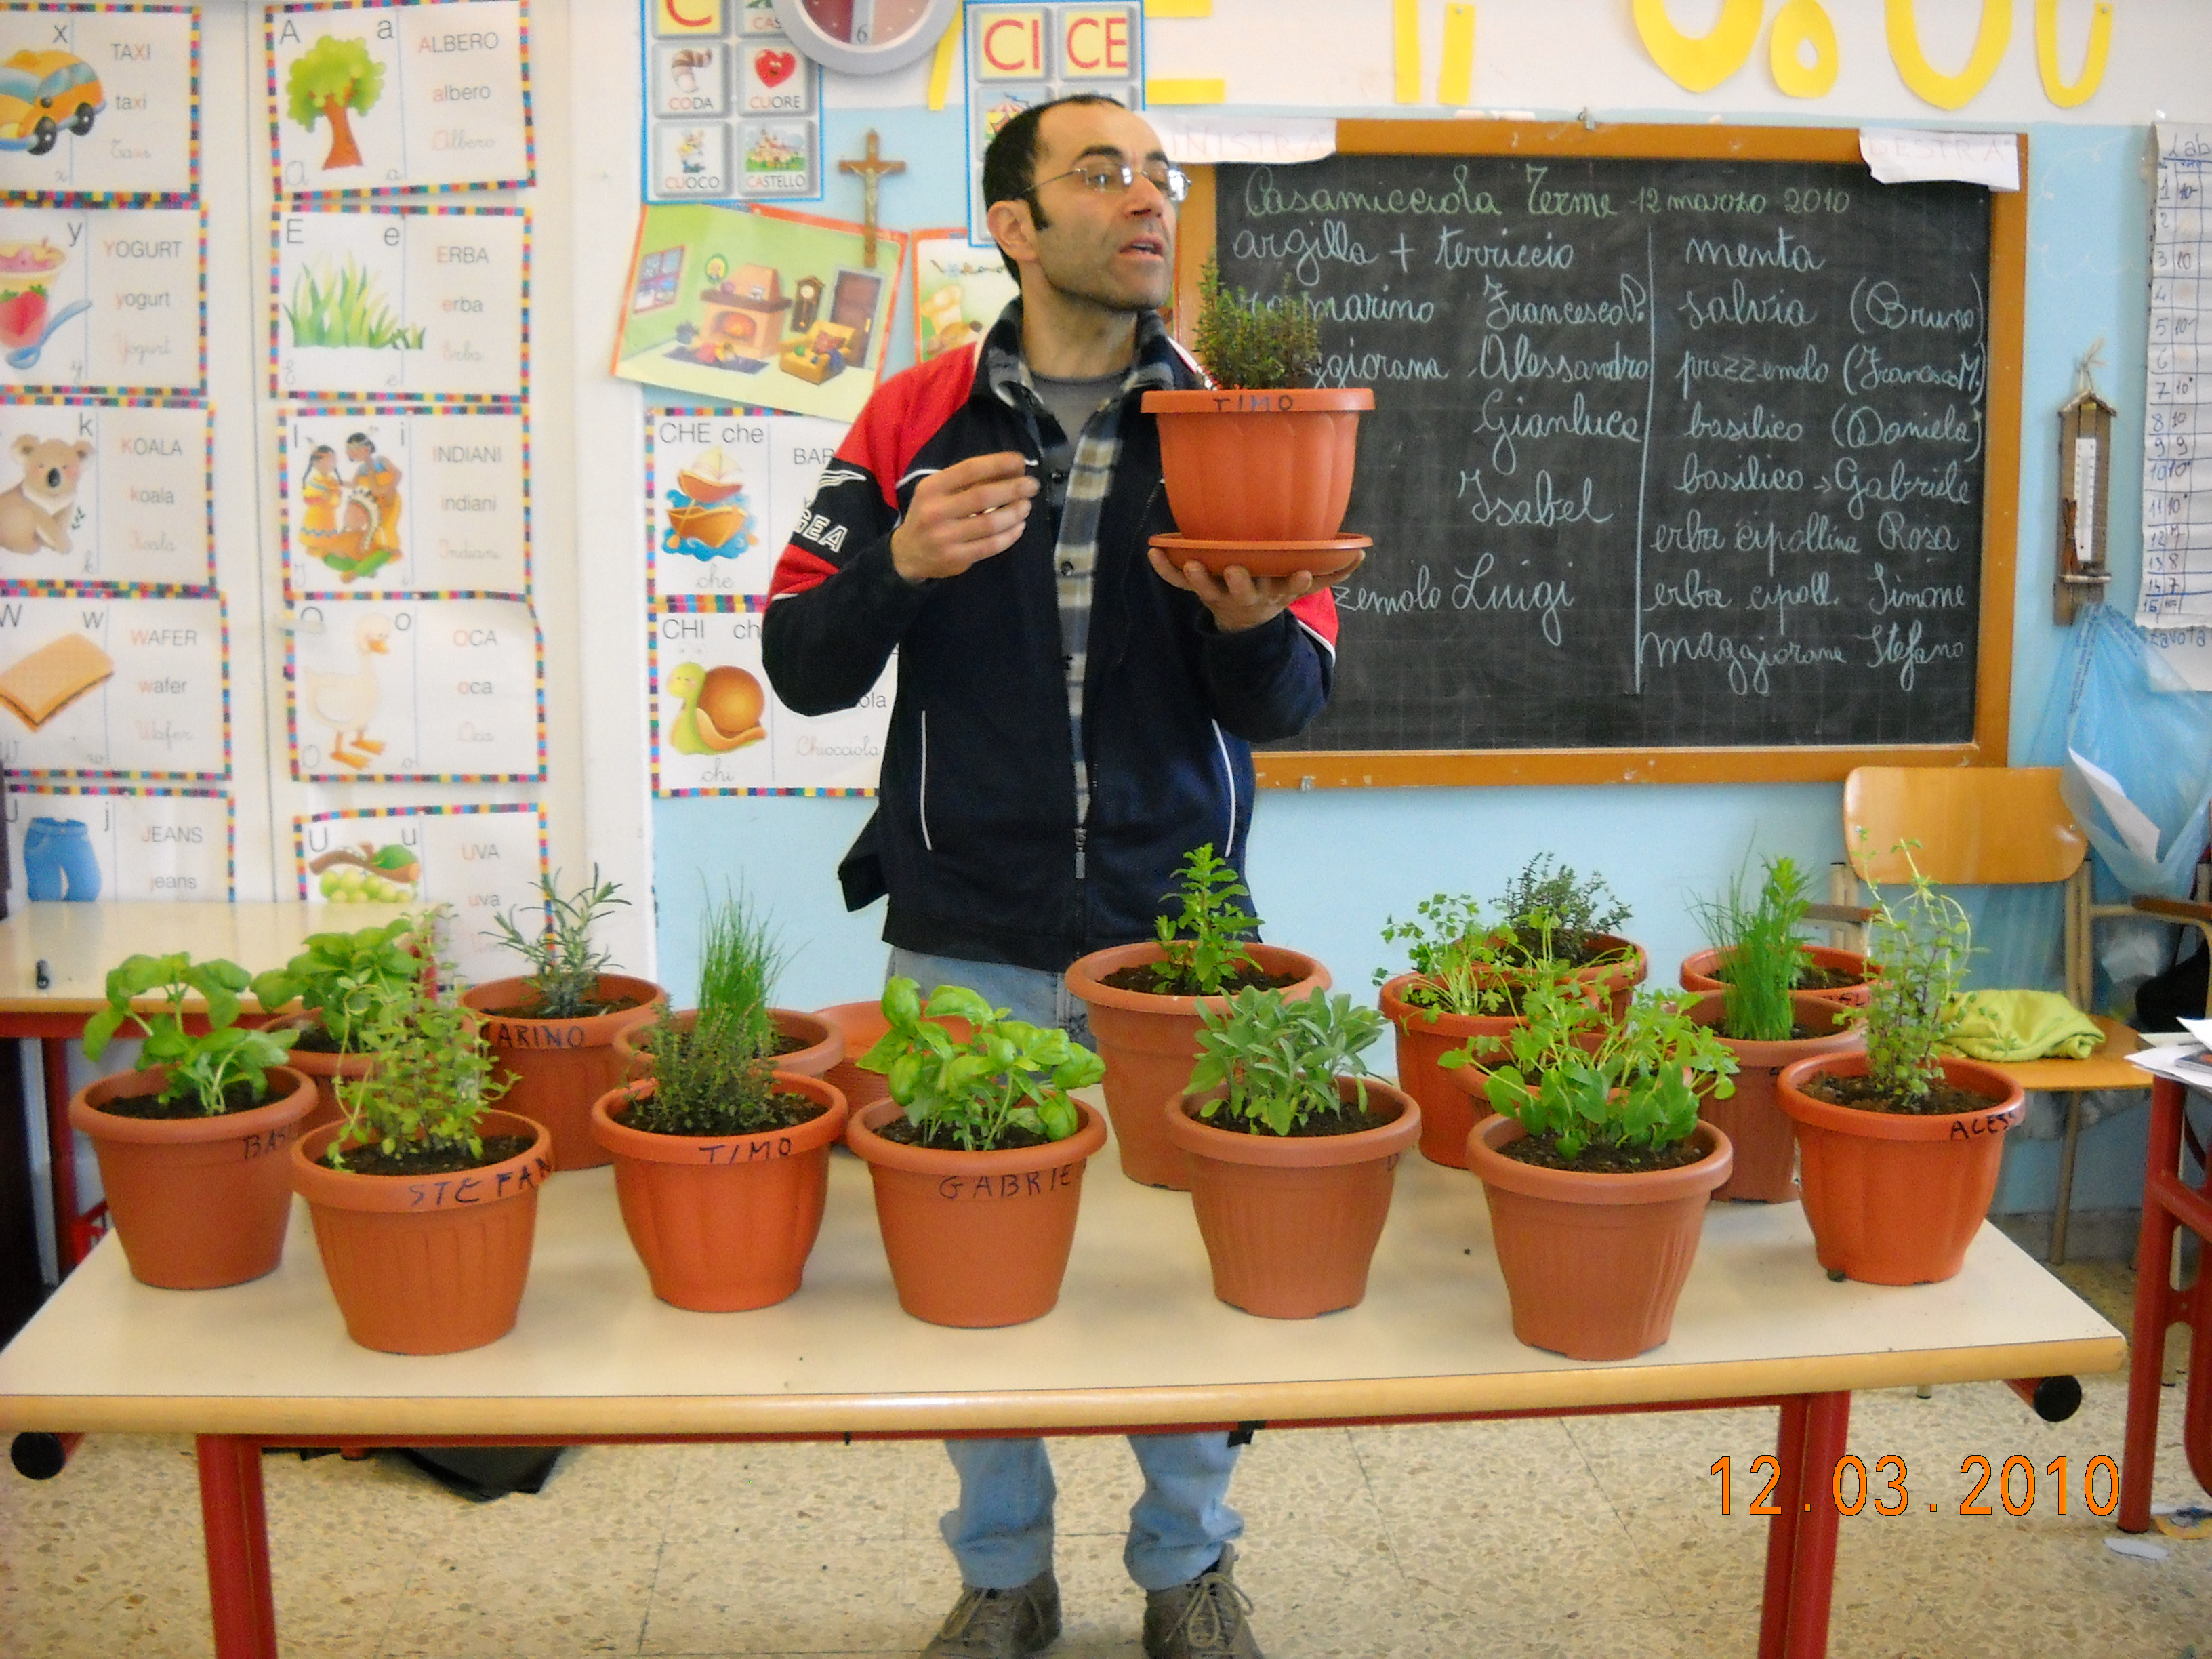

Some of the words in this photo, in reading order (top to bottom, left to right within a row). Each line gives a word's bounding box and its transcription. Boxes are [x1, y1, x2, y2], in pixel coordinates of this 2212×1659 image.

[752, 16, 783, 29] CAS
[279, 20, 300, 45] A
[377, 20, 396, 39] a
[856, 23, 868, 43] 6
[110, 43, 151, 61] TAXI
[419, 32, 499, 54] ALBERO
[983, 19, 1040, 70] CI
[1066, 18, 1128, 68] CE
[115, 95, 147, 110] taxi
[433, 85, 491, 103] albero
[669, 97, 714, 110] CODA
[750, 96, 800, 108] CUORE
[432, 129, 497, 151] Albero
[665, 177, 720, 189] CUOCO
[747, 176, 805, 188] CASTELLO
[1525, 163, 1618, 218] Terme
[1667, 190, 1766, 214] marzo
[1784, 187, 1850, 214] 2010
[2160, 212, 2169, 228] 2
[286, 219, 304, 244] E
[384, 227, 400, 246] e
[104, 241, 182, 258] YOGURT
[436, 247, 489, 264] ERBA
[1233, 219, 1378, 286] argilla
[1435, 226, 1574, 270] terriccio
[1685, 226, 1826, 272] menta
[2158, 251, 2167, 267] 3
[2177, 251, 2191, 270] 10
[115, 291, 171, 310] yogurt
[442, 296, 483, 312] erba
[1678, 279, 1818, 331] salvia
[2156, 317, 2169, 336] 5
[1468, 335, 1651, 383] Alessandro
[2156, 382, 2170, 400] 7
[1213, 395, 1293, 411] TIMO
[1684, 401, 1803, 441] basilico
[2152, 413, 2163, 432] 8
[659, 423, 710, 443] CHE
[722, 423, 764, 443] che
[121, 438, 182, 455] KOALA
[433, 446, 501, 463] INDIANI
[2155, 438, 2165, 457] 9
[2176, 436, 2188, 455] 9
[2150, 462, 2167, 480] 10
[1675, 453, 1804, 494] basilico
[1834, 457, 1971, 520] Gabriele
[130, 489, 174, 504] koala
[442, 495, 497, 512] indiani
[1458, 469, 1614, 528] Isabel
[2149, 499, 2162, 518] 11
[1650, 509, 1726, 553] erba
[1877, 510, 1959, 553] Rosa
[2152, 531, 2165, 548] 12
[2169, 553, 2178, 569] 8
[697, 564, 734, 589] che
[2169, 577, 2180, 594] 7
[1643, 569, 1732, 611] erba
[1867, 562, 1965, 615] Simone
[1452, 552, 1575, 647] Luigi
[131, 630, 197, 647] WAFER
[453, 630, 497, 647] OCA
[662, 619, 705, 639] CHI
[734, 619, 762, 639] ch
[1855, 619, 1965, 691] Stefano
[139, 678, 186, 693] wafer
[459, 681, 493, 695] oca
[796, 735, 880, 756] Chiocciola
[701, 759, 734, 783] chi
[141, 826, 203, 844] JEANS
[309, 828, 328, 853] U
[401, 830, 417, 846] u
[461, 844, 500, 860] UVA
[150, 874, 197, 891] jeans
[468, 893, 501, 908] uva
[699, 1137, 792, 1164] TIMO
[938, 1162, 1073, 1200] GABRIE
